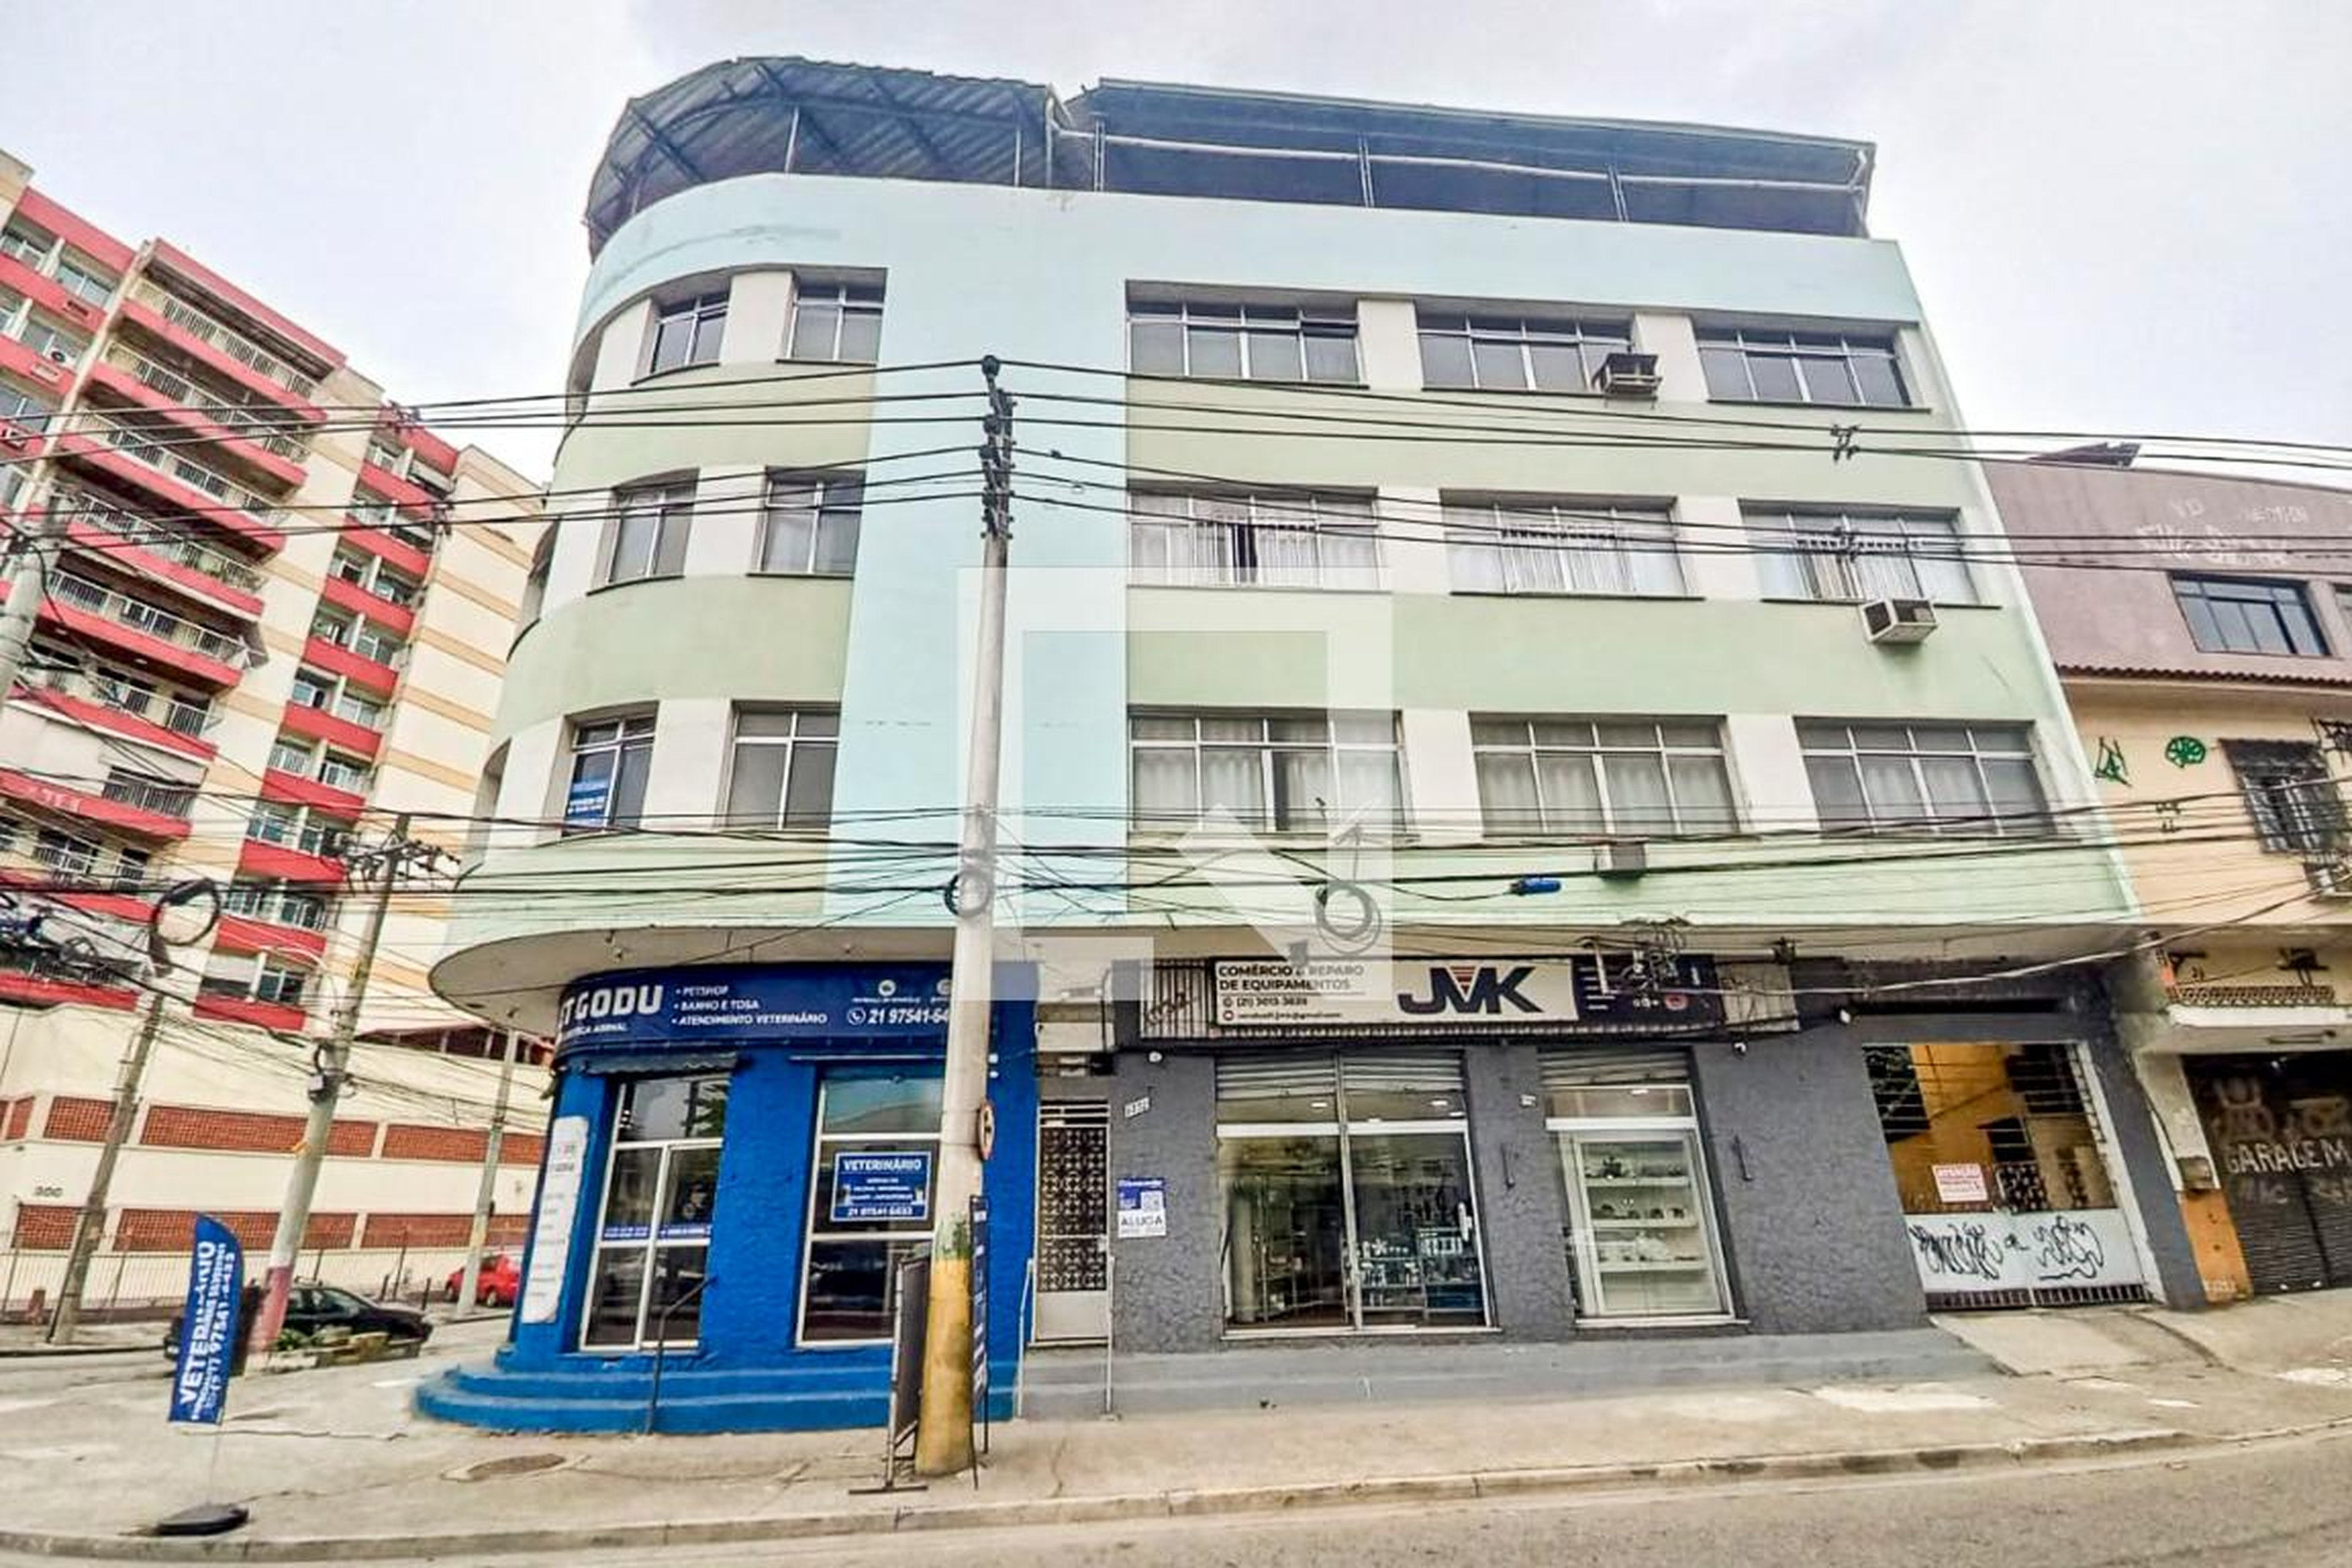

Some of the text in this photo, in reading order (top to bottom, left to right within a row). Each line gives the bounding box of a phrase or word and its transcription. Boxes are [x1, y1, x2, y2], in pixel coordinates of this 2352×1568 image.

[1218, 964, 1292, 977] COMÉRCIO
[1309, 965, 1364, 977] REPARO
[682, 985, 729, 997] PETSHOP
[1219, 979, 1351, 991] DE EQUIPAMENTOS
[1397, 967, 1545, 1015] JMK
[680, 999, 760, 1011] BANHO E TOSA
[677, 1012, 828, 1026] ATENDIMENTO VETERINÁRIO
[867, 1008, 885, 1024] 21
[842, 1158, 922, 1171] VETERINÁRIO
[1120, 1215, 1163, 1227] ALUGA
